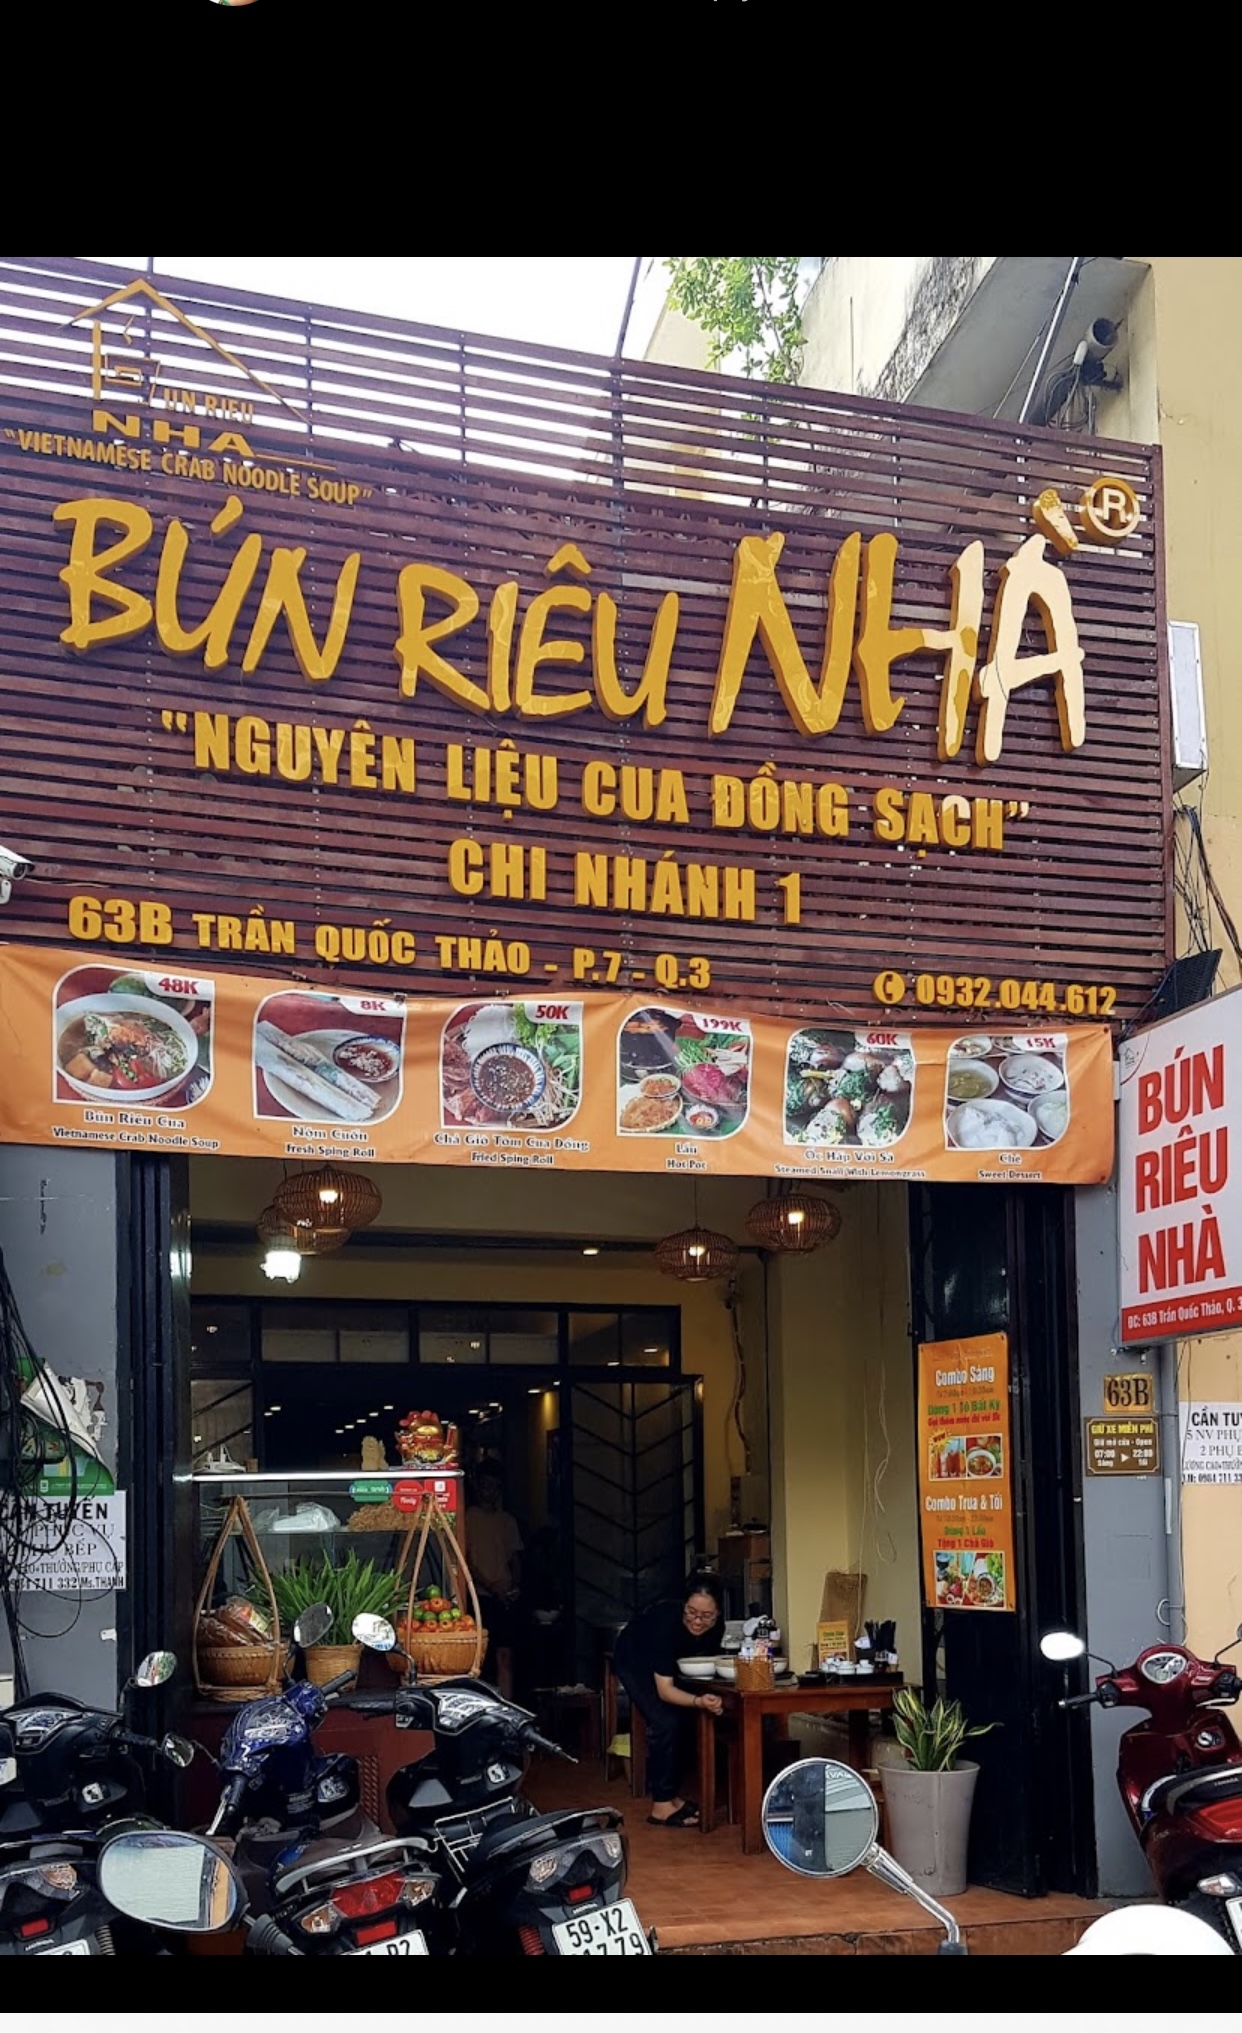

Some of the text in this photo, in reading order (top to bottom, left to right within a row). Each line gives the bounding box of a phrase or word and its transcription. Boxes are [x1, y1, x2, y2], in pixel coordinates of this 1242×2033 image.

[93, 409, 256, 458] NHA
[161, 451, 215, 481] CRAB
[224, 466, 299, 496] NOODLE
[53, 488, 1085, 766] BÚN RIÊU NHÀ
[447, 739, 558, 821] LIỆU
[582, 760, 689, 824] CUA
[711, 761, 849, 838] ĐỒNG
[449, 838, 801, 924] CHI NHÁNH 1
[68, 895, 174, 945] 63B
[192, 904, 297, 955] TRẦN
[315, 918, 416, 964] QUỐC
[435, 929, 531, 975] THẢO
[573, 947, 623, 983] P.7
[655, 953, 711, 990] Q.3
[158, 977, 200, 995] 48K
[916, 974, 1118, 1016] 0932.044.612
[360, 1000, 387, 1012] 8K
[535, 1004, 570, 1020] 50K
[701, 1017, 745, 1033] 199K
[866, 1033, 899, 1047] 60K
[1026, 1037, 1058, 1049] 15K
[1138, 1045, 1225, 1135] BÚN
[85, 1109, 187, 1128] Bún Riêu Cua
[53, 1127, 219, 1150] Vietnamese Crab Noodle Soup
[331, 1128, 368, 1142] Cuốn
[526, 1137, 551, 1148] Cua
[318, 1145, 349, 1158] Sping
[353, 1147, 375, 1158] Roll
[471, 1151, 553, 1166] Fried Sping Roll
[666, 1158, 707, 1169] Hot Pot
[774, 1164, 926, 1178] Steamed Snail With Lemongrass
[1136, 1124, 1228, 1214] RIÊU
[978, 1169, 1042, 1179] Sweet Dessert
[1138, 1203, 1226, 1294] NHÀ
[1142, 1311, 1158, 1327] 63B
[1178, 1302, 1199, 1321] Quốc
[1226, 1298, 1236, 1313] Q.
[935, 1365, 995, 1387] Combo Sáng
[1107, 1378, 1150, 1406] 63B
[1191, 1405, 1219, 1427] CẦN
[1106, 1424, 1117, 1434] XE
[1196, 1429, 1214, 1440] NV
[1199, 1444, 1206, 1456] 2
[1209, 1444, 1234, 1458] PHỤ
[925, 1495, 956, 1511] Combo
[980, 1494, 987, 1510] &
[989, 1491, 1003, 1510] Tối
[57, 1577, 77, 1588] 332
[566, 1907, 629, 1948] 59-X2
